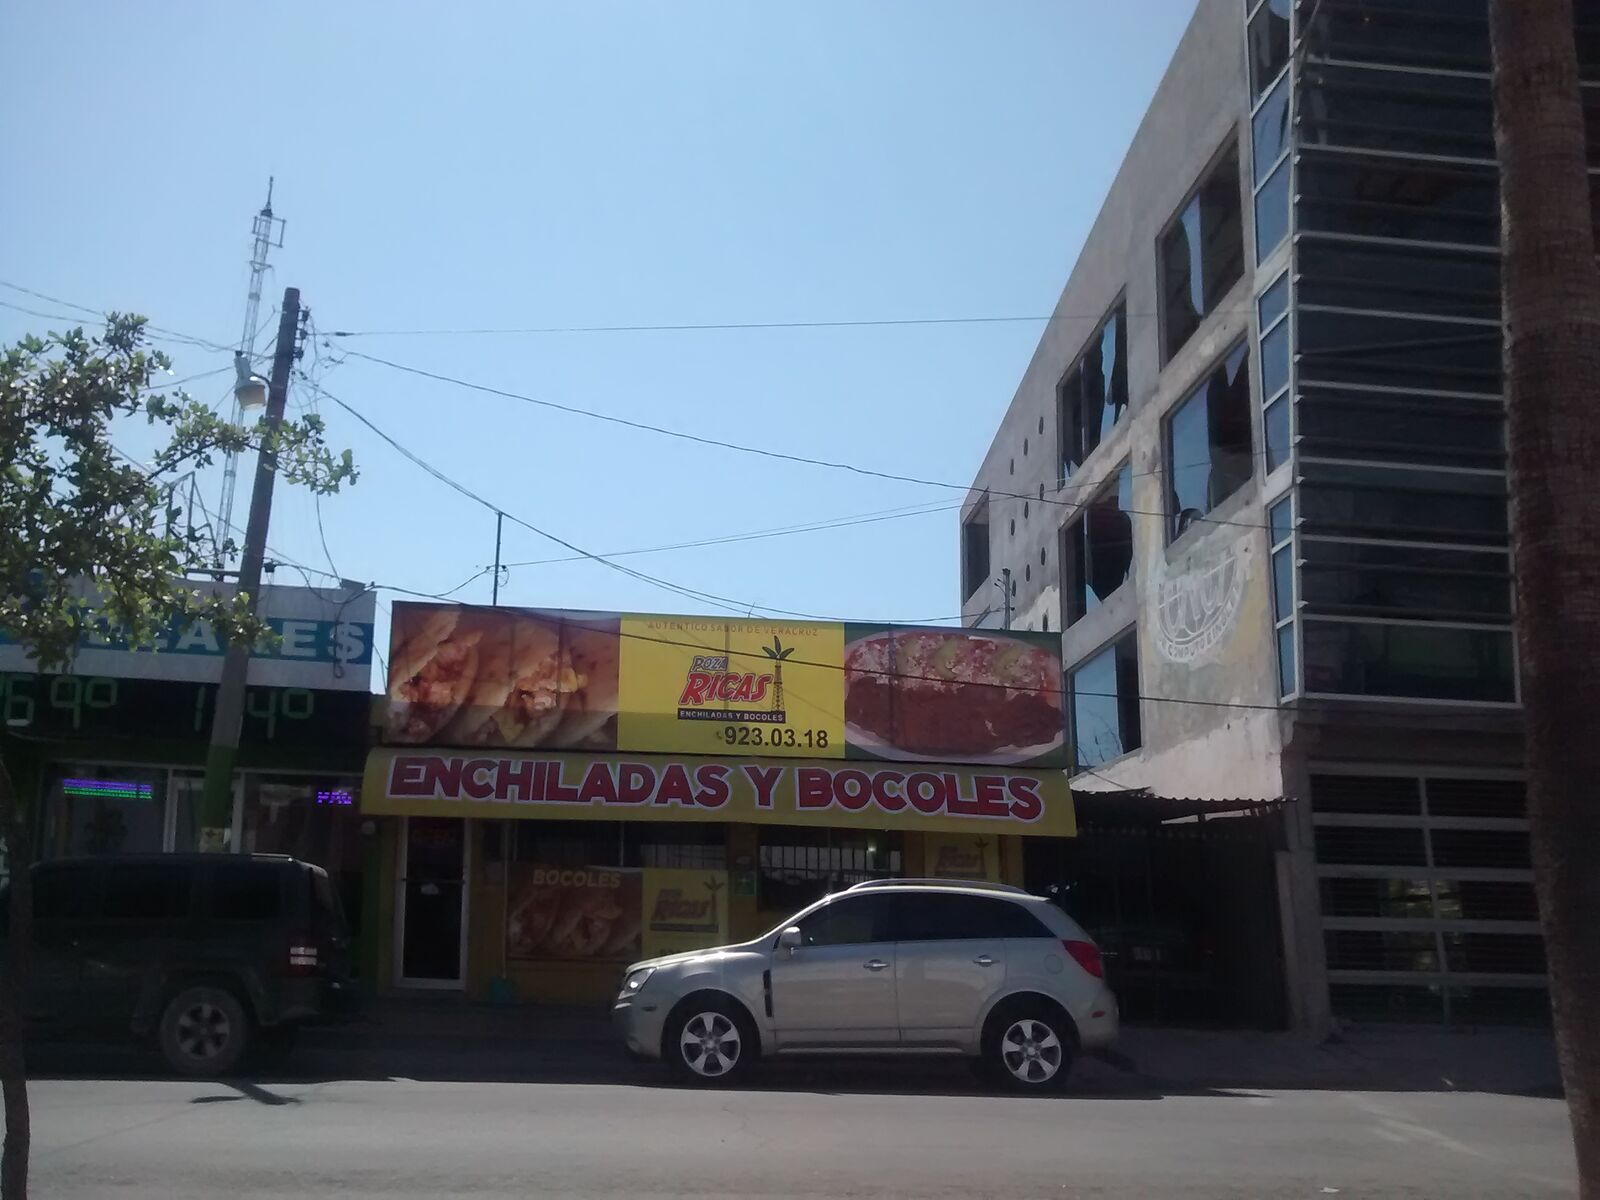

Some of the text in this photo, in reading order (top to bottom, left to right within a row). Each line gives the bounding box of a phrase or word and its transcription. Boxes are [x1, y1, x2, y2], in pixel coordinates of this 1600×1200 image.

[648, 621, 818, 637] AUTENTICO SABOR DE VERACRUZ
[690, 655, 729, 672] POZA
[678, 671, 774, 706] RICAS
[680, 710, 783, 722] ENCHILADAS Y BOCOLES
[724, 726, 828, 748] 923.03.18
[386, 755, 1046, 823] ENCHILADAS Y BOCOLES
[532, 868, 622, 889] BOCOLES
